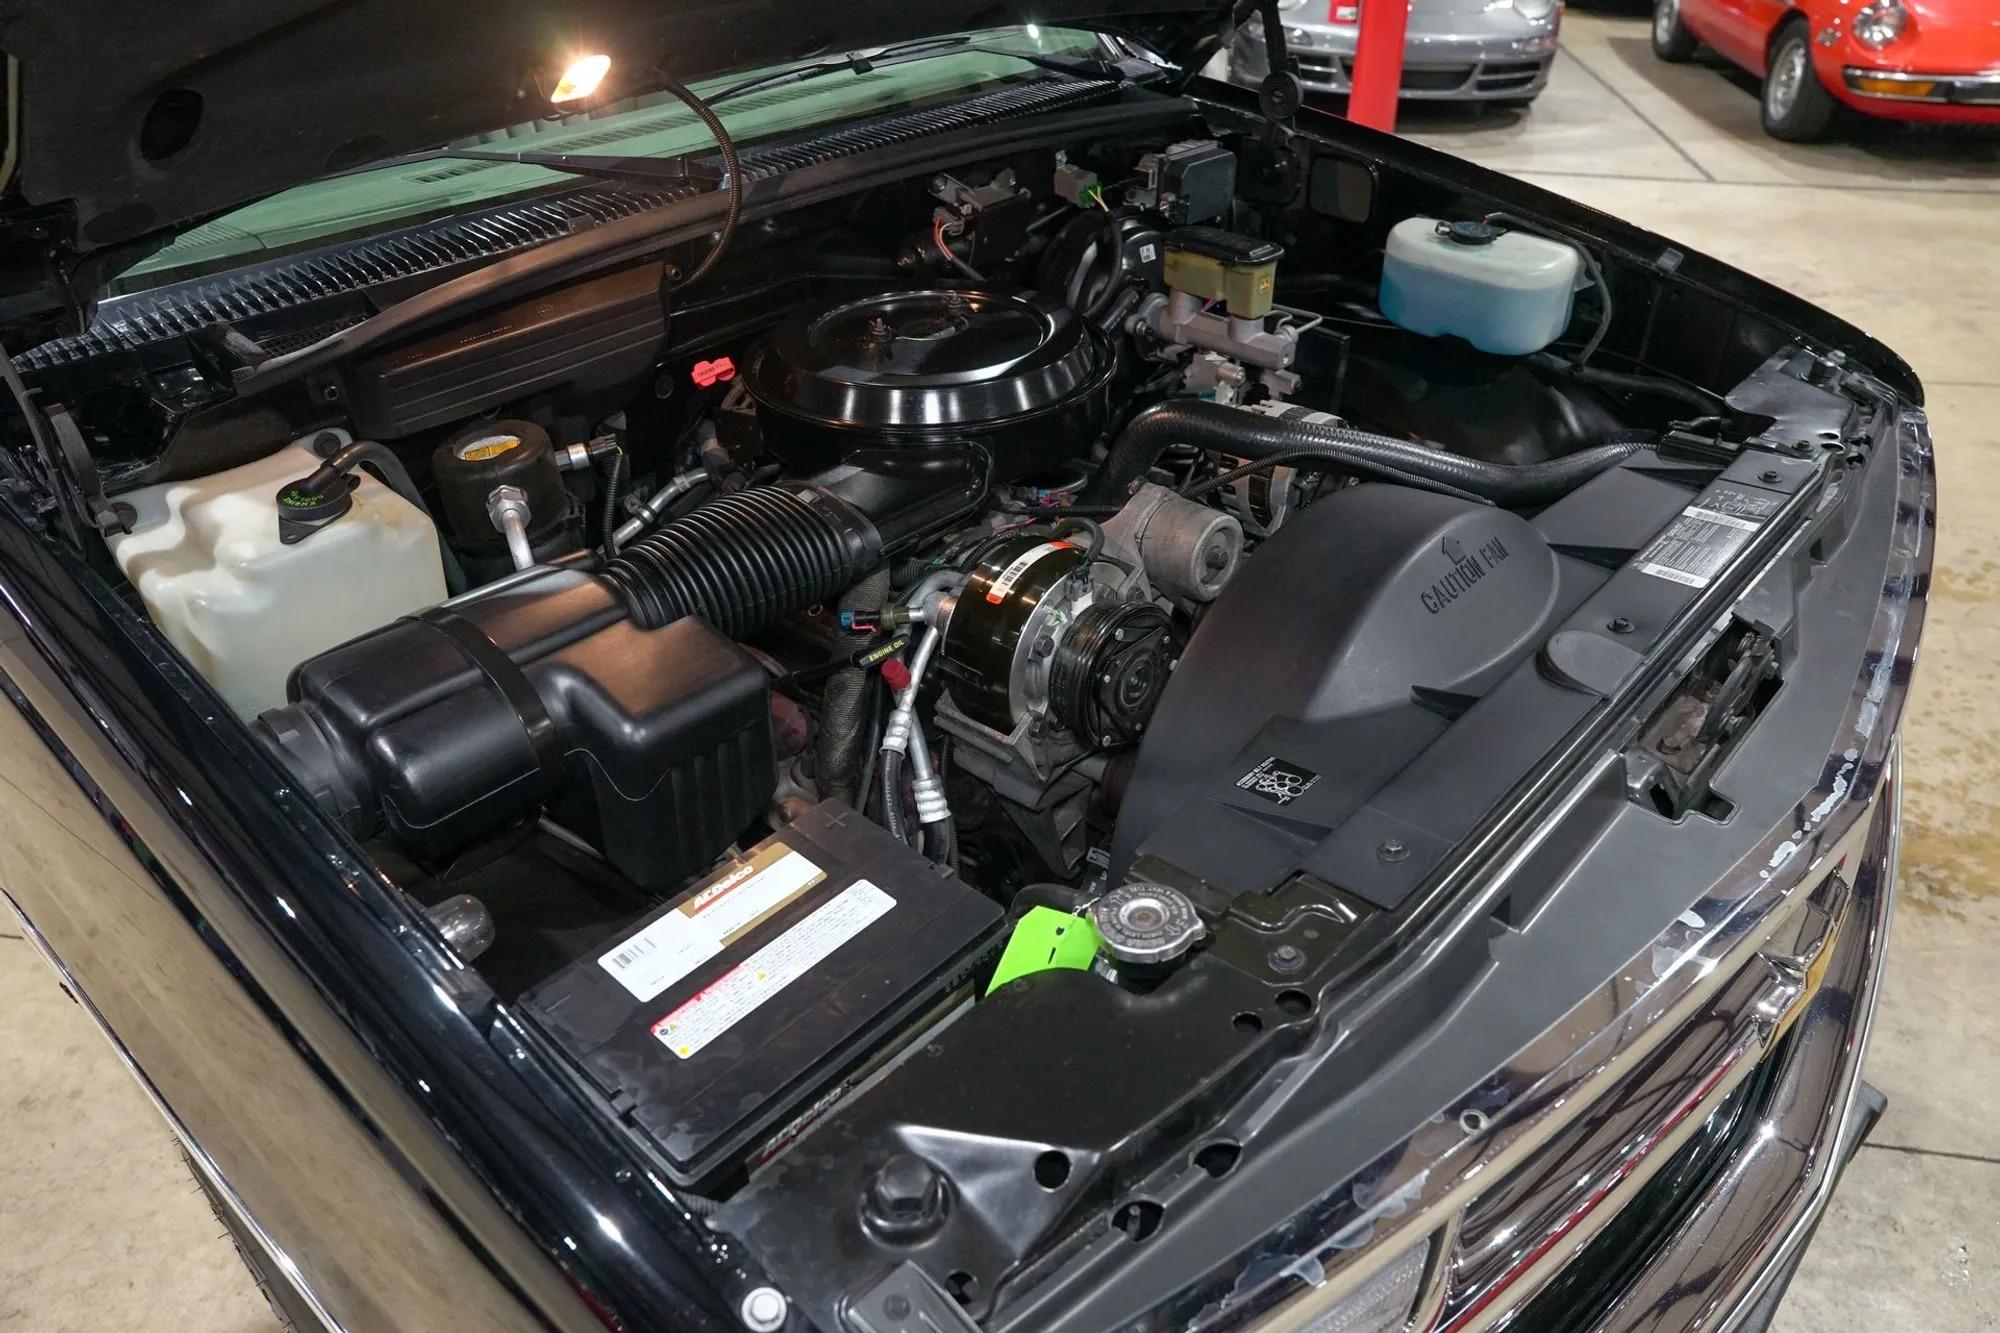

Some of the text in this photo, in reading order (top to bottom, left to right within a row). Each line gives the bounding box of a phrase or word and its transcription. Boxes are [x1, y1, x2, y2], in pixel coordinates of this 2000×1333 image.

[1420, 536, 1509, 614] CAUTION FAN
[868, 639, 905, 661] ENGINE OIL
[694, 865, 755, 909] ACDelco
